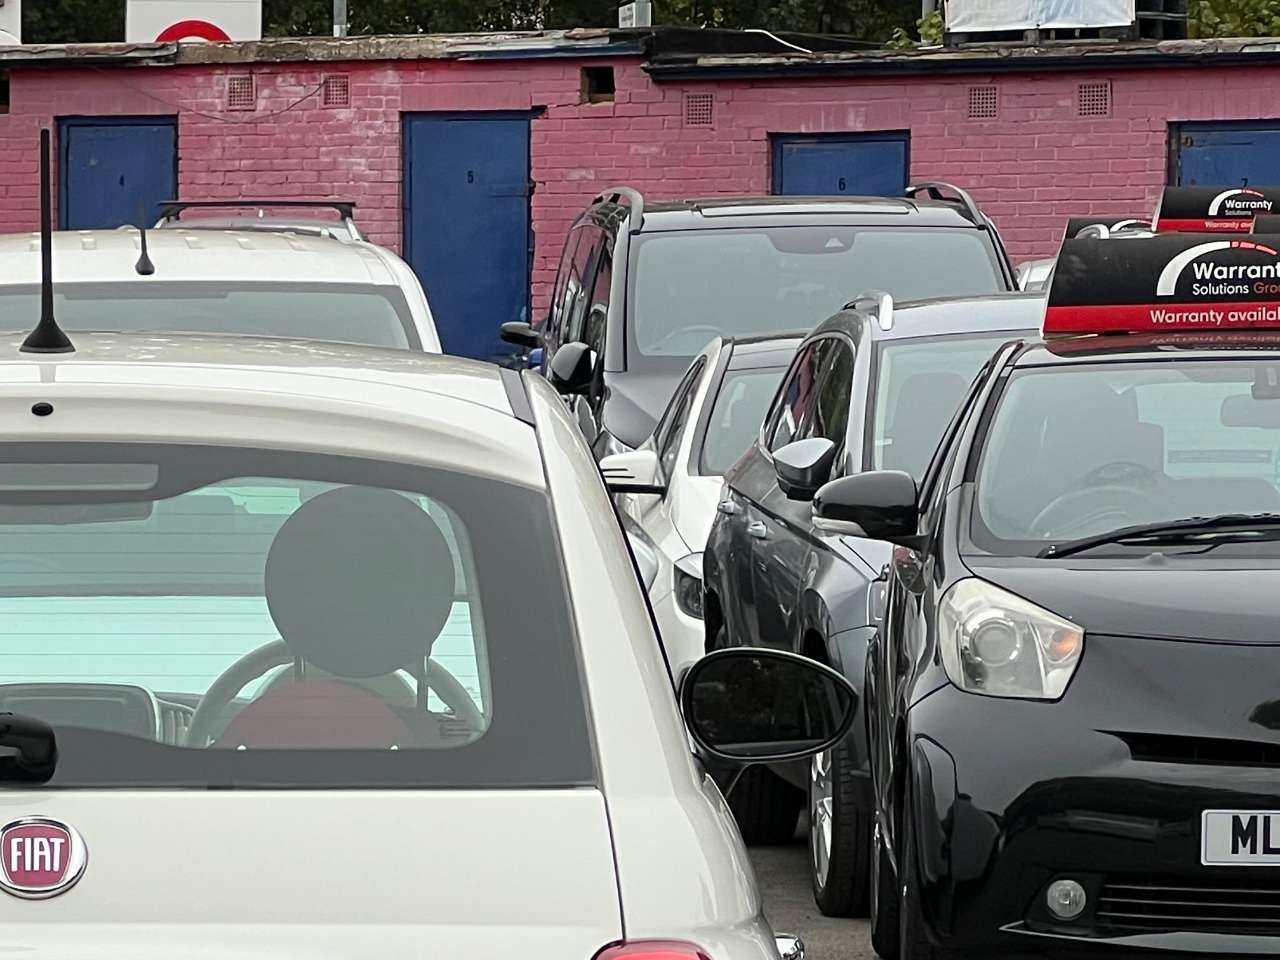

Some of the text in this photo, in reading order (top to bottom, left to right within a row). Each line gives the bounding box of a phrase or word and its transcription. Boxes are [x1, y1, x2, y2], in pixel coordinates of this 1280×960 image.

[467, 170, 474, 184] 5
[838, 177, 846, 191] 6
[1224, 199, 1273, 211] Warranty
[1192, 281, 1280, 296] Solutions Gro
[1149, 309, 1224, 326] Warranty
[10, 836, 66, 873] FIAT
